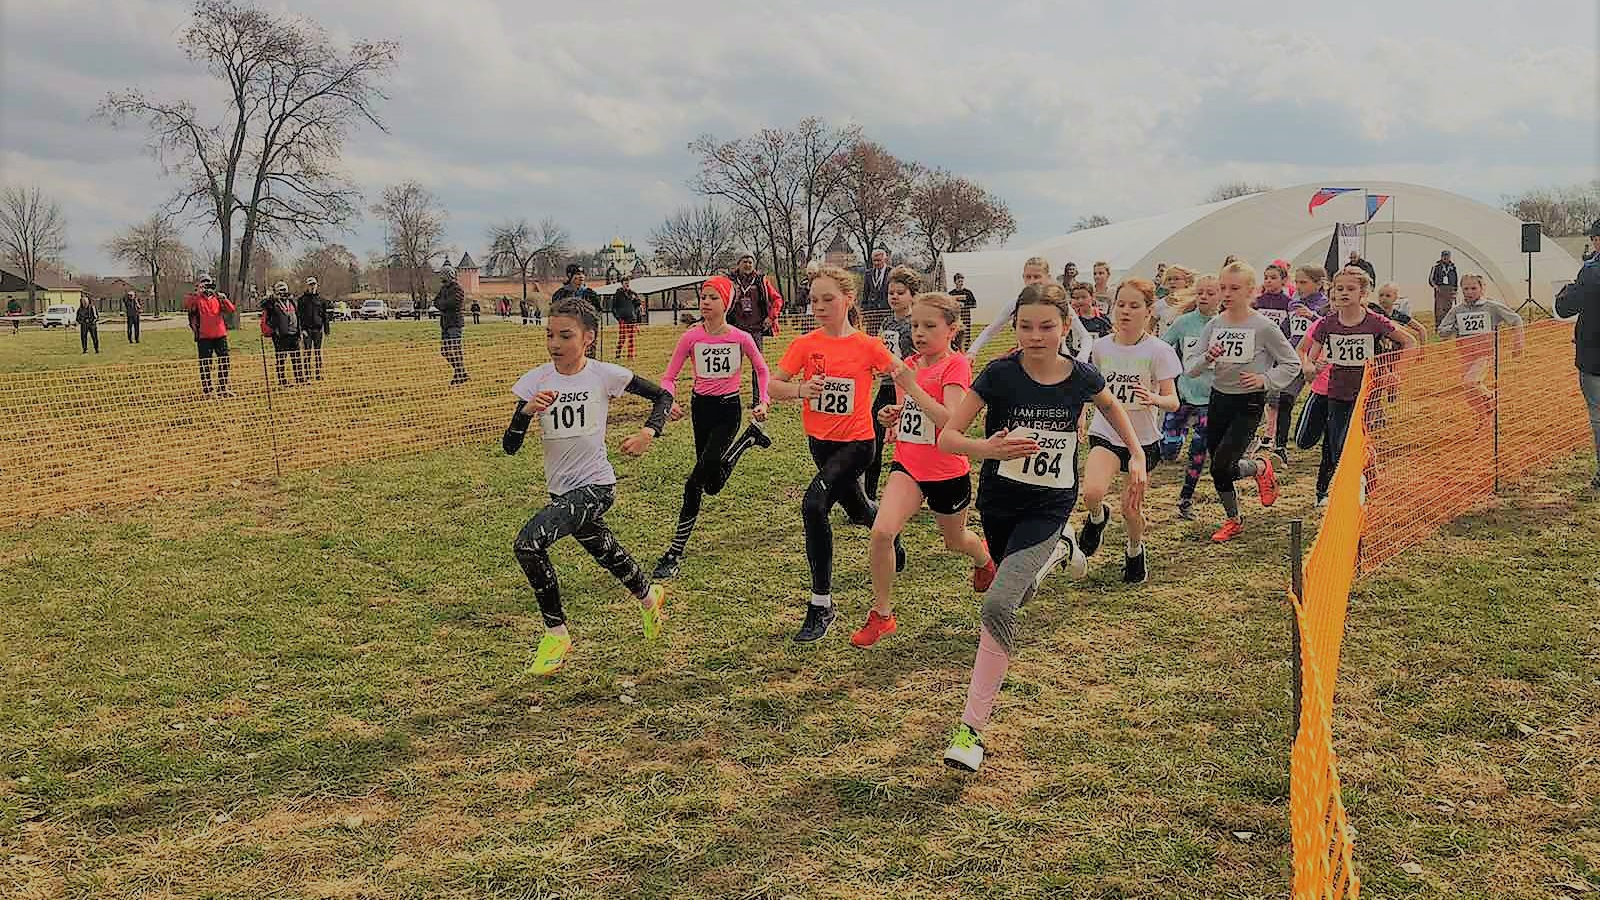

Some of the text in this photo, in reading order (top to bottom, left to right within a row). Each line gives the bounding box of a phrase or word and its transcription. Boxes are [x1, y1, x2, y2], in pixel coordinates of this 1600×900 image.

[1339, 346, 1365, 361] 218
[704, 356, 731, 373] 154
[823, 381, 851, 393] asics
[559, 391, 589, 403] asics
[817, 393, 848, 414] 128
[550, 404, 585, 430] 101
[1018, 408, 1034, 418] AM
[1036, 408, 1071, 418] FRESH
[1038, 437, 1068, 450] asics
[1021, 451, 1063, 479] 164
